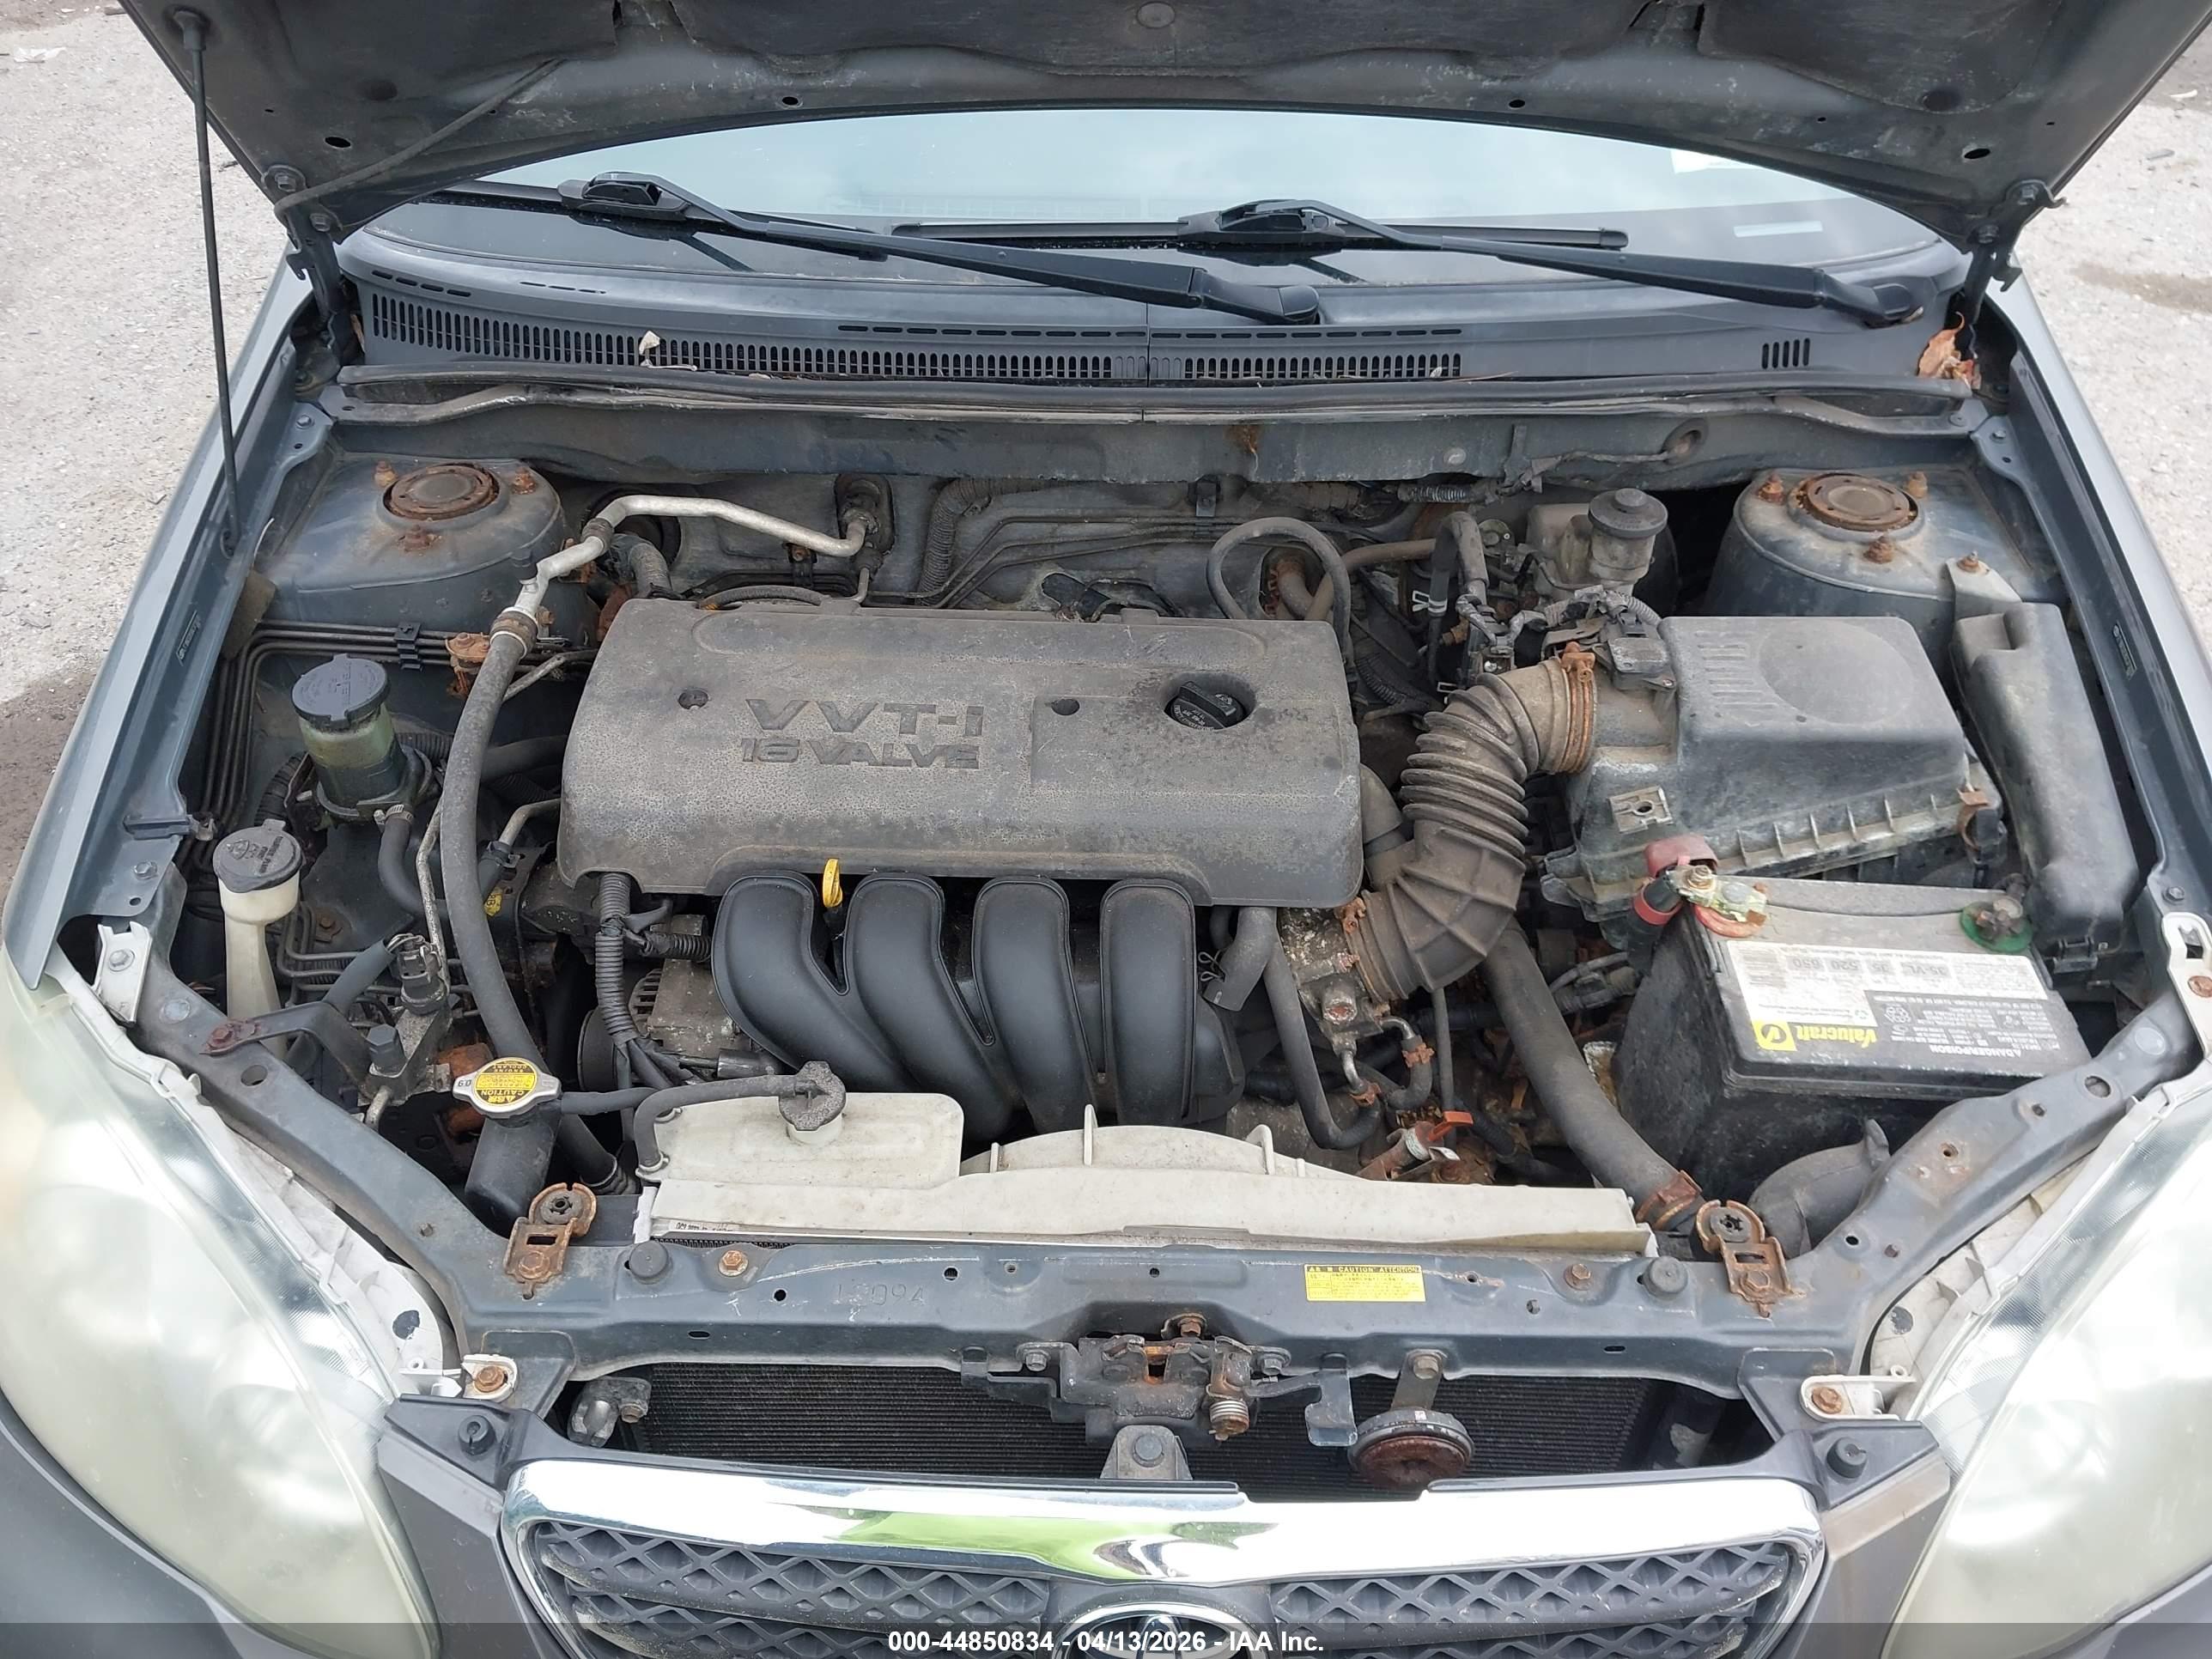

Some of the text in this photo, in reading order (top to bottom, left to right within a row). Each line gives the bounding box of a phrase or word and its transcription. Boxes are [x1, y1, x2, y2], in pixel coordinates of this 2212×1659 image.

[807, 740, 979, 769] VALVE
[1831, 959, 1859, 971] 520
[1795, 1024, 1877, 1048] Valucraft
